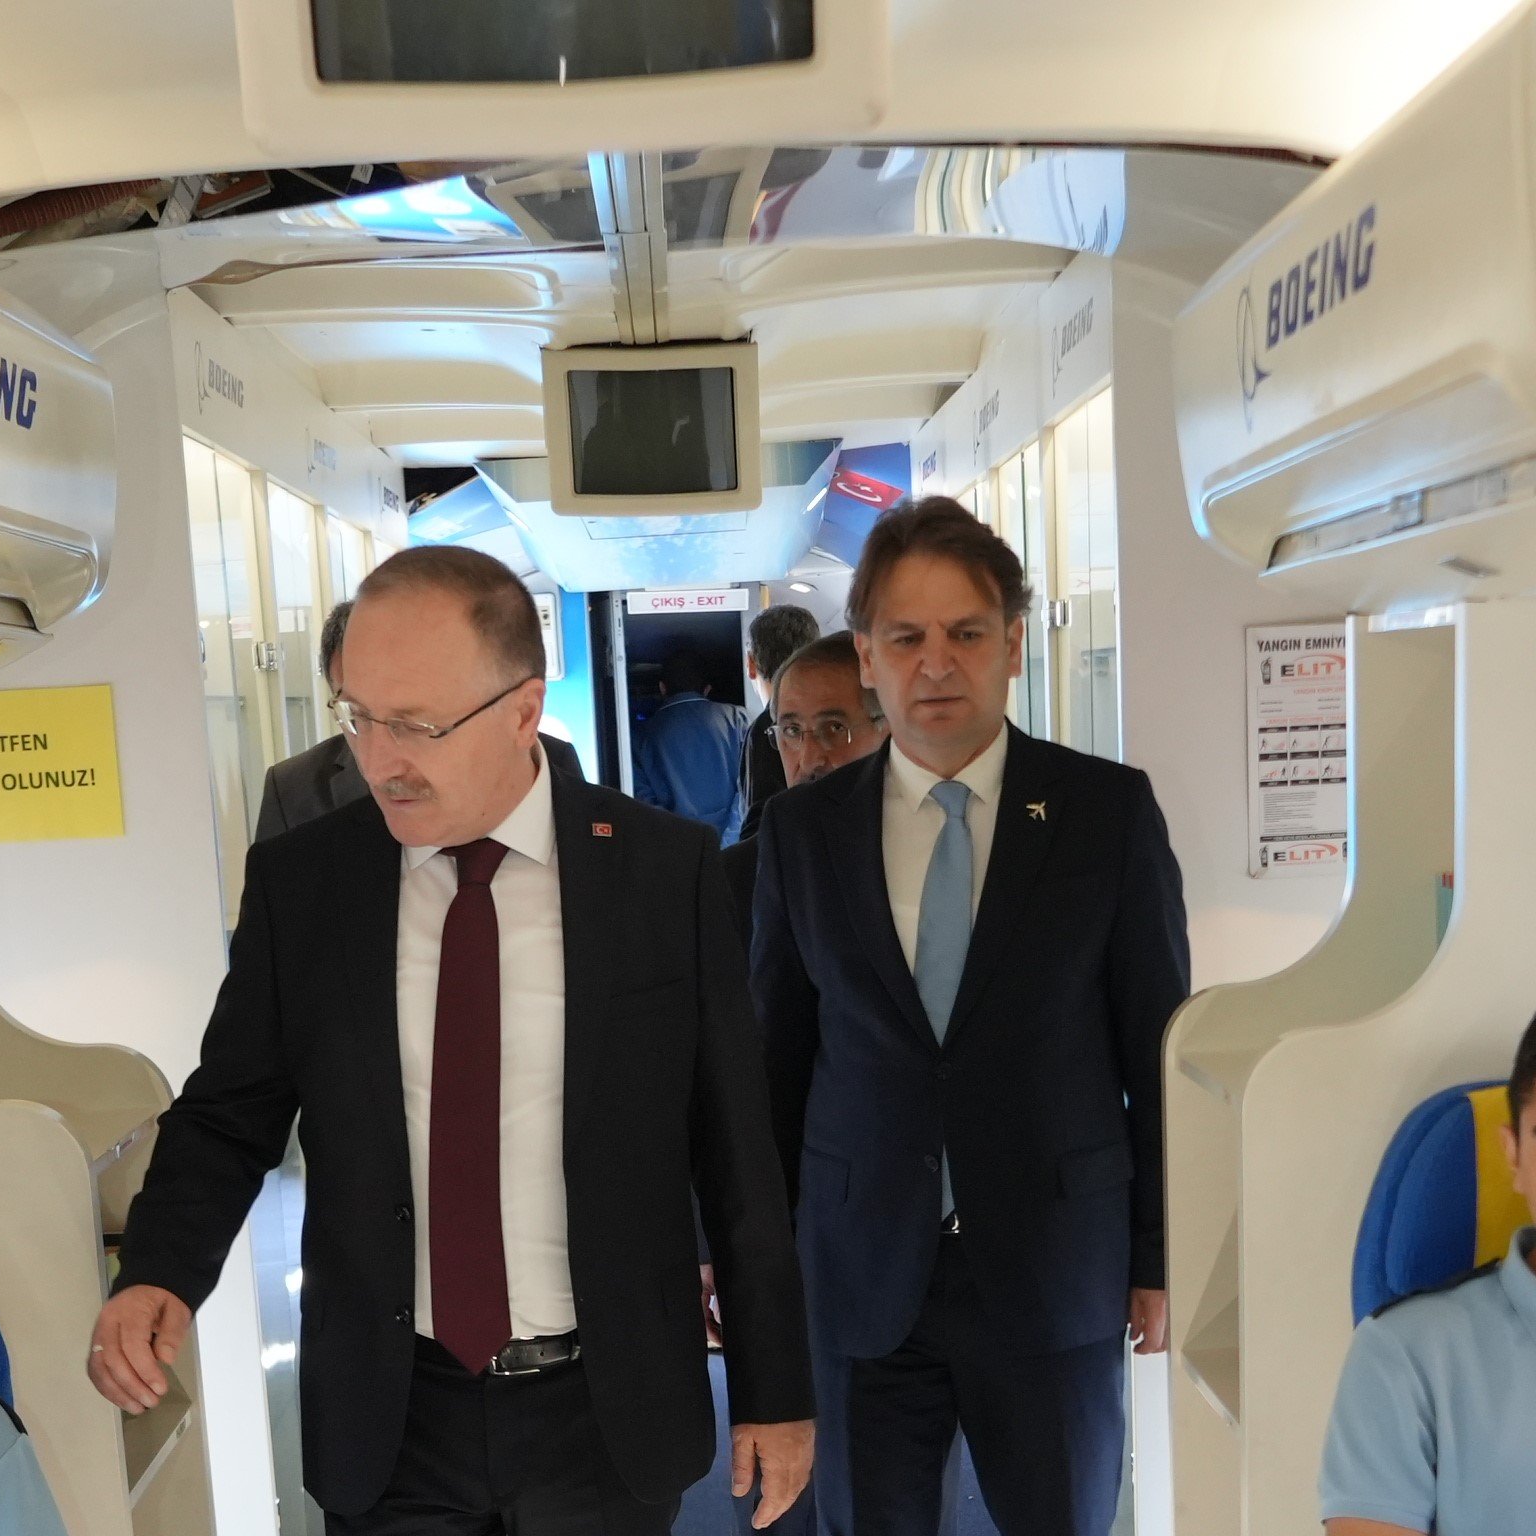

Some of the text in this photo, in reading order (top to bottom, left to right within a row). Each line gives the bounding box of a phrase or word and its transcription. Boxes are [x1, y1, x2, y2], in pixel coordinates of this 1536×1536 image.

[1266, 203, 1376, 352] BOEING
[1061, 296, 1094, 359] BOEING
[208, 358, 244, 409] BOEING
[979, 388, 1000, 435] BOEING
[651, 597, 686, 608] ÇIKIŞ
[697, 596, 726, 606] EXIT
[1257, 638, 1301, 653] YANGIN
[1, 768, 96, 791] OLUNUZ!
